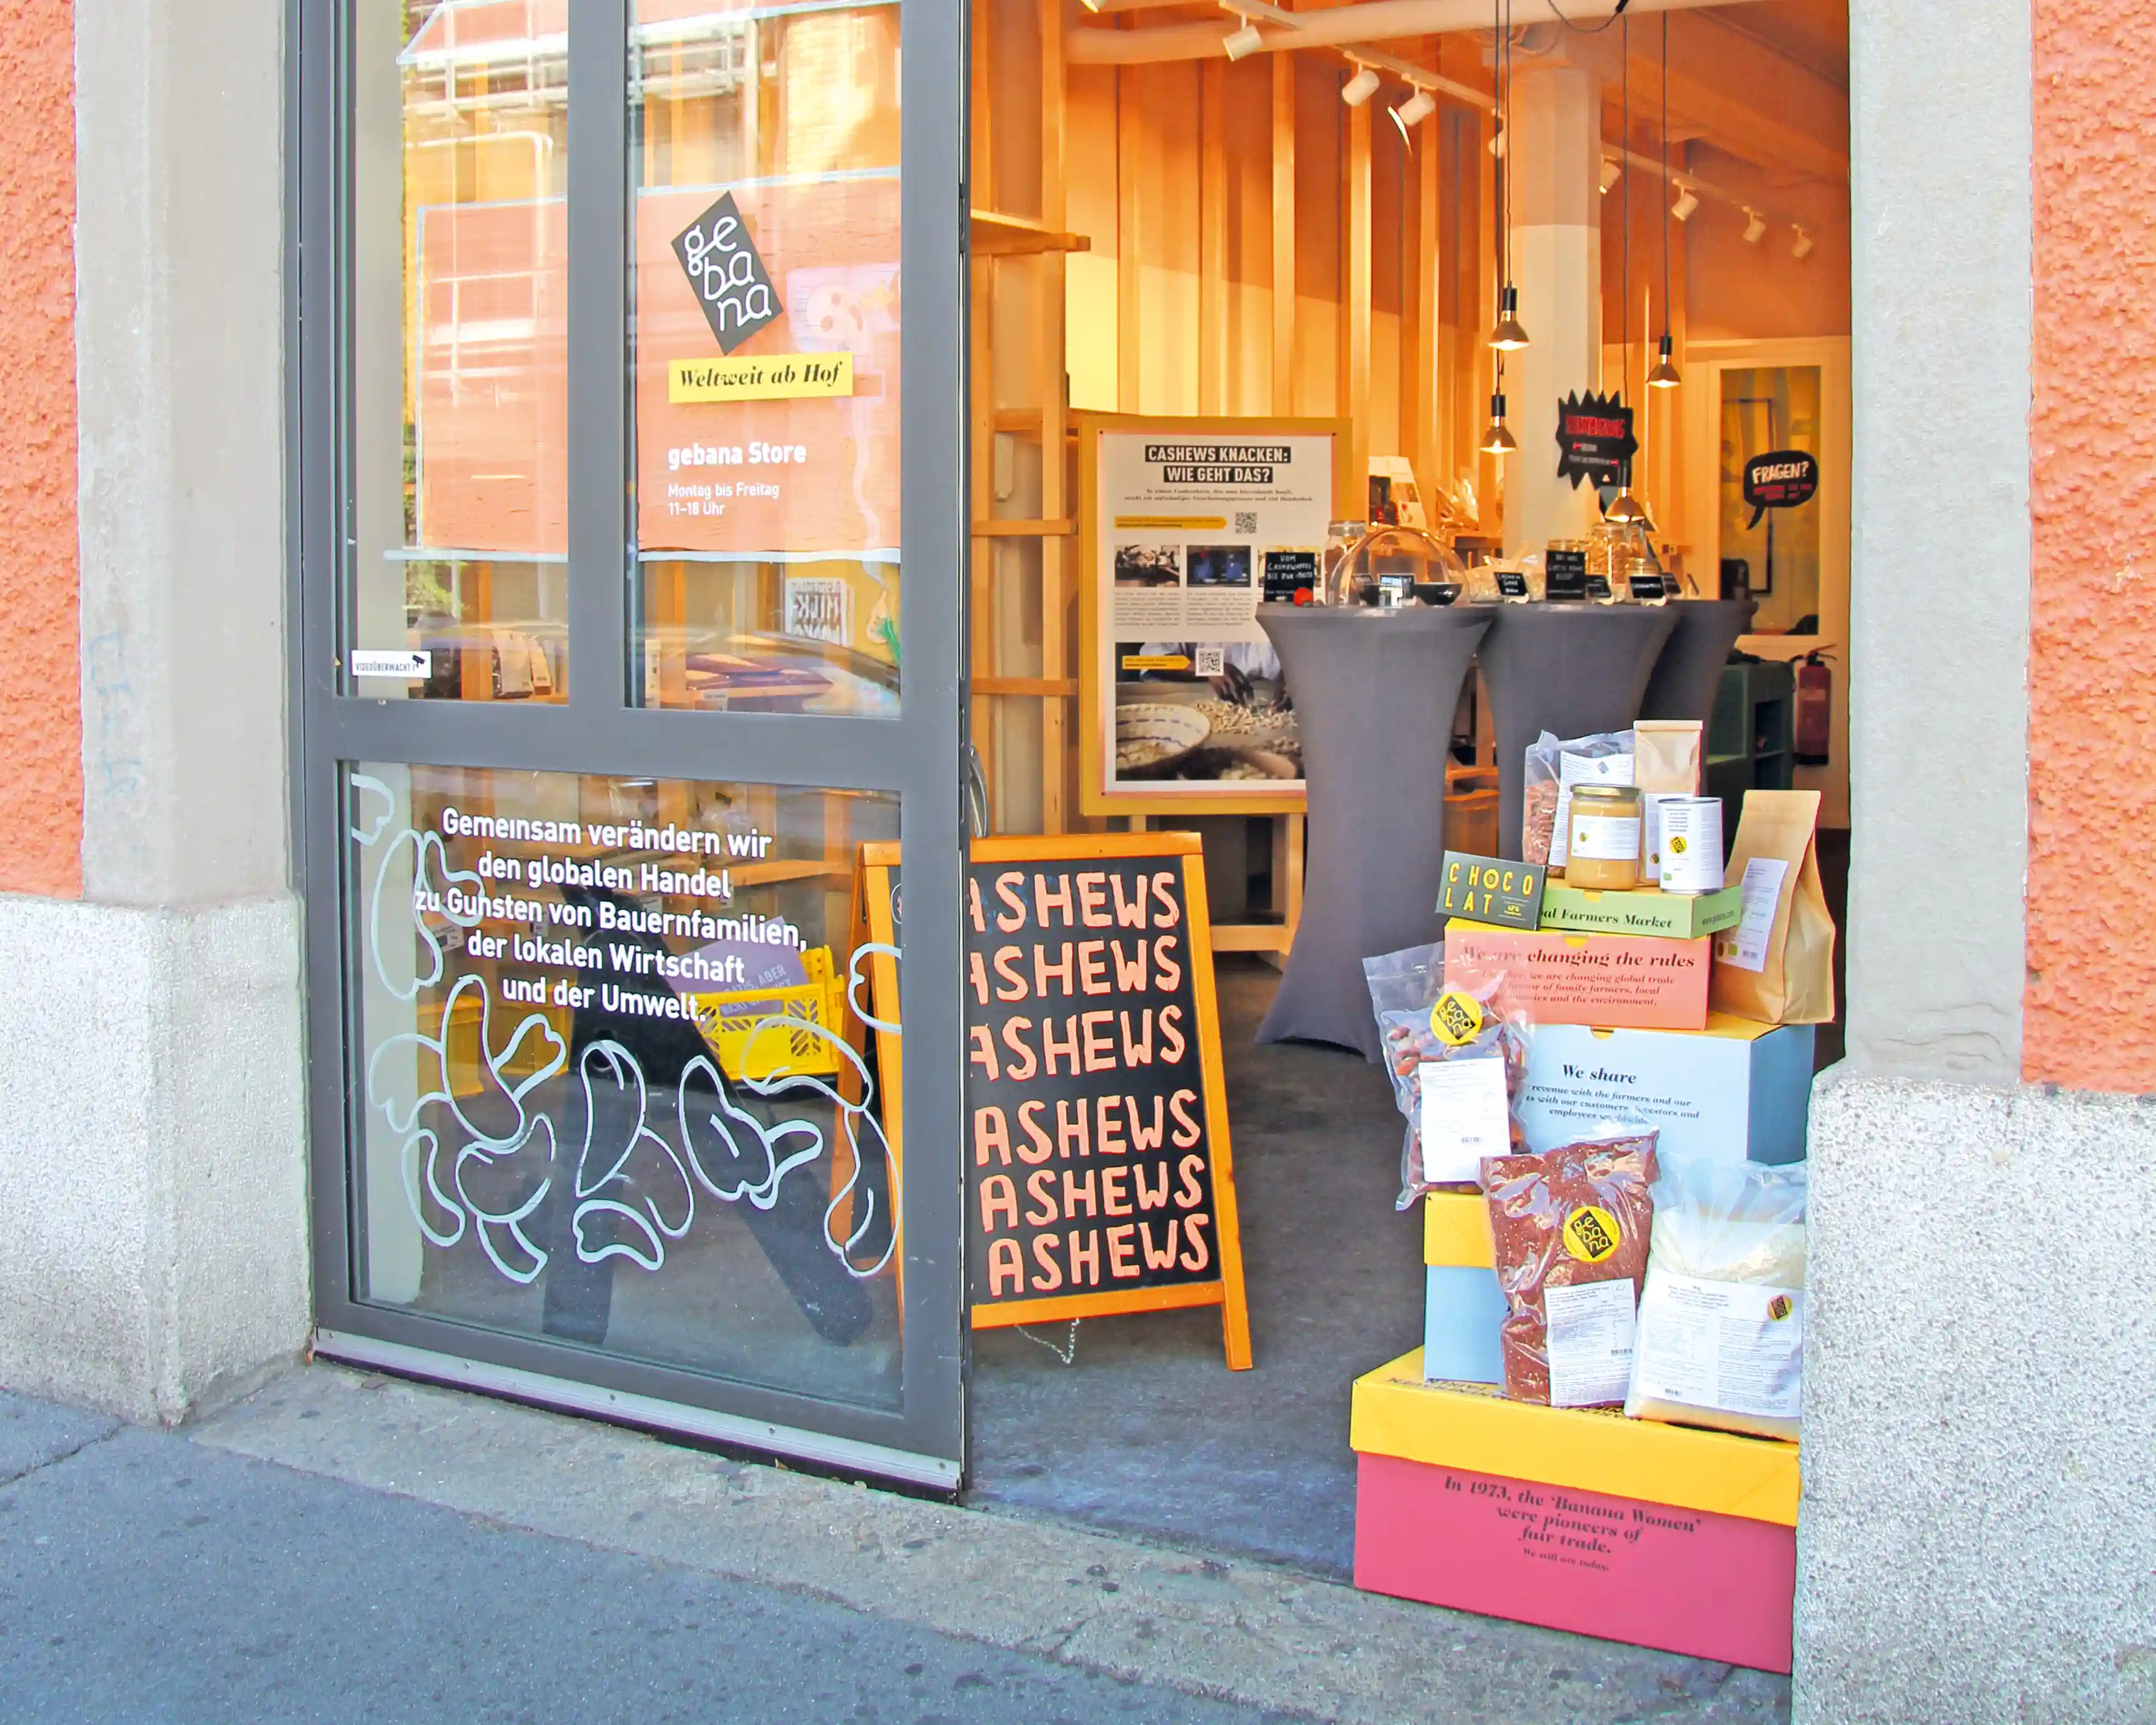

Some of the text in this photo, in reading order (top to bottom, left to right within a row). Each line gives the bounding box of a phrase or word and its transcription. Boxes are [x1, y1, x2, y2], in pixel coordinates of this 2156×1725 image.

[680, 361, 843, 388] Weltweit ab Hof
[668, 441, 807, 470] gebana Store
[1148, 447, 1288, 462] CASHEWS KNACKEN:
[1167, 467, 1270, 482] WIE GEHT DAS?
[1752, 461, 1809, 484] FRAGEN?
[668, 482, 780, 500] Montag bis Freitag
[703, 501, 725, 515] Uhr
[442, 807, 772, 860] Gemeinsam verändern wir
[478, 850, 731, 899] den globalen Handel
[414, 888, 808, 953] zu Gunsten von Bauernfamilien,
[1561, 909, 1619, 924] Farmers
[1623, 915, 1673, 929] Market
[468, 930, 507, 960] der
[513, 935, 603, 969] lokalen
[610, 943, 745, 983] Wirtschaft
[1464, 946, 1485, 961] We
[1528, 949, 1610, 967] changing
[1616, 952, 1644, 966] the
[1650, 953, 1695, 968] rules
[758, 965, 786, 984] ABER
[1565, 972, 1611, 983] changing
[1615, 974, 1646, 984] global
[1648, 976, 1675, 984] trade
[502, 976, 707, 1022] und der Umwelt.
[1543, 983, 1553, 992] of
[1555, 983, 1587, 994] family
[1589, 984, 1632, 994] farmers,
[1635, 986, 1660, 995] local
[1550, 994, 1569, 1003] and
[1572, 995, 1588, 1003] the
[1590, 996, 1657, 1006] environment.
[970, 1004, 1185, 1081] ASHEWS
[1563, 1064, 1637, 1084] We share
[1532, 1084, 1568, 1094] revenue
[1571, 1088, 1591, 1097] with
[1595, 1091, 1609, 1099] the
[1610, 1092, 1650, 1103] farmers
[1653, 1097, 1671, 1105] and
[1538, 1096, 1558, 1104] with
[1549, 1109, 1596, 1119] employees
[973, 1089, 1201, 1166] ASHEWS
[979, 1154, 1205, 1233] ASHEWS
[988, 1213, 1208, 1296] ASHEWS
[1444, 1476, 1462, 1492] In
[1470, 1480, 1512, 1501] 1973,
[1518, 1490, 1544, 1506] the
[1497, 1507, 1643, 1544] were pioneers of
[1518, 1525, 1611, 1553] fair trade.
[1523, 1548, 1610, 1572] We still are today.
